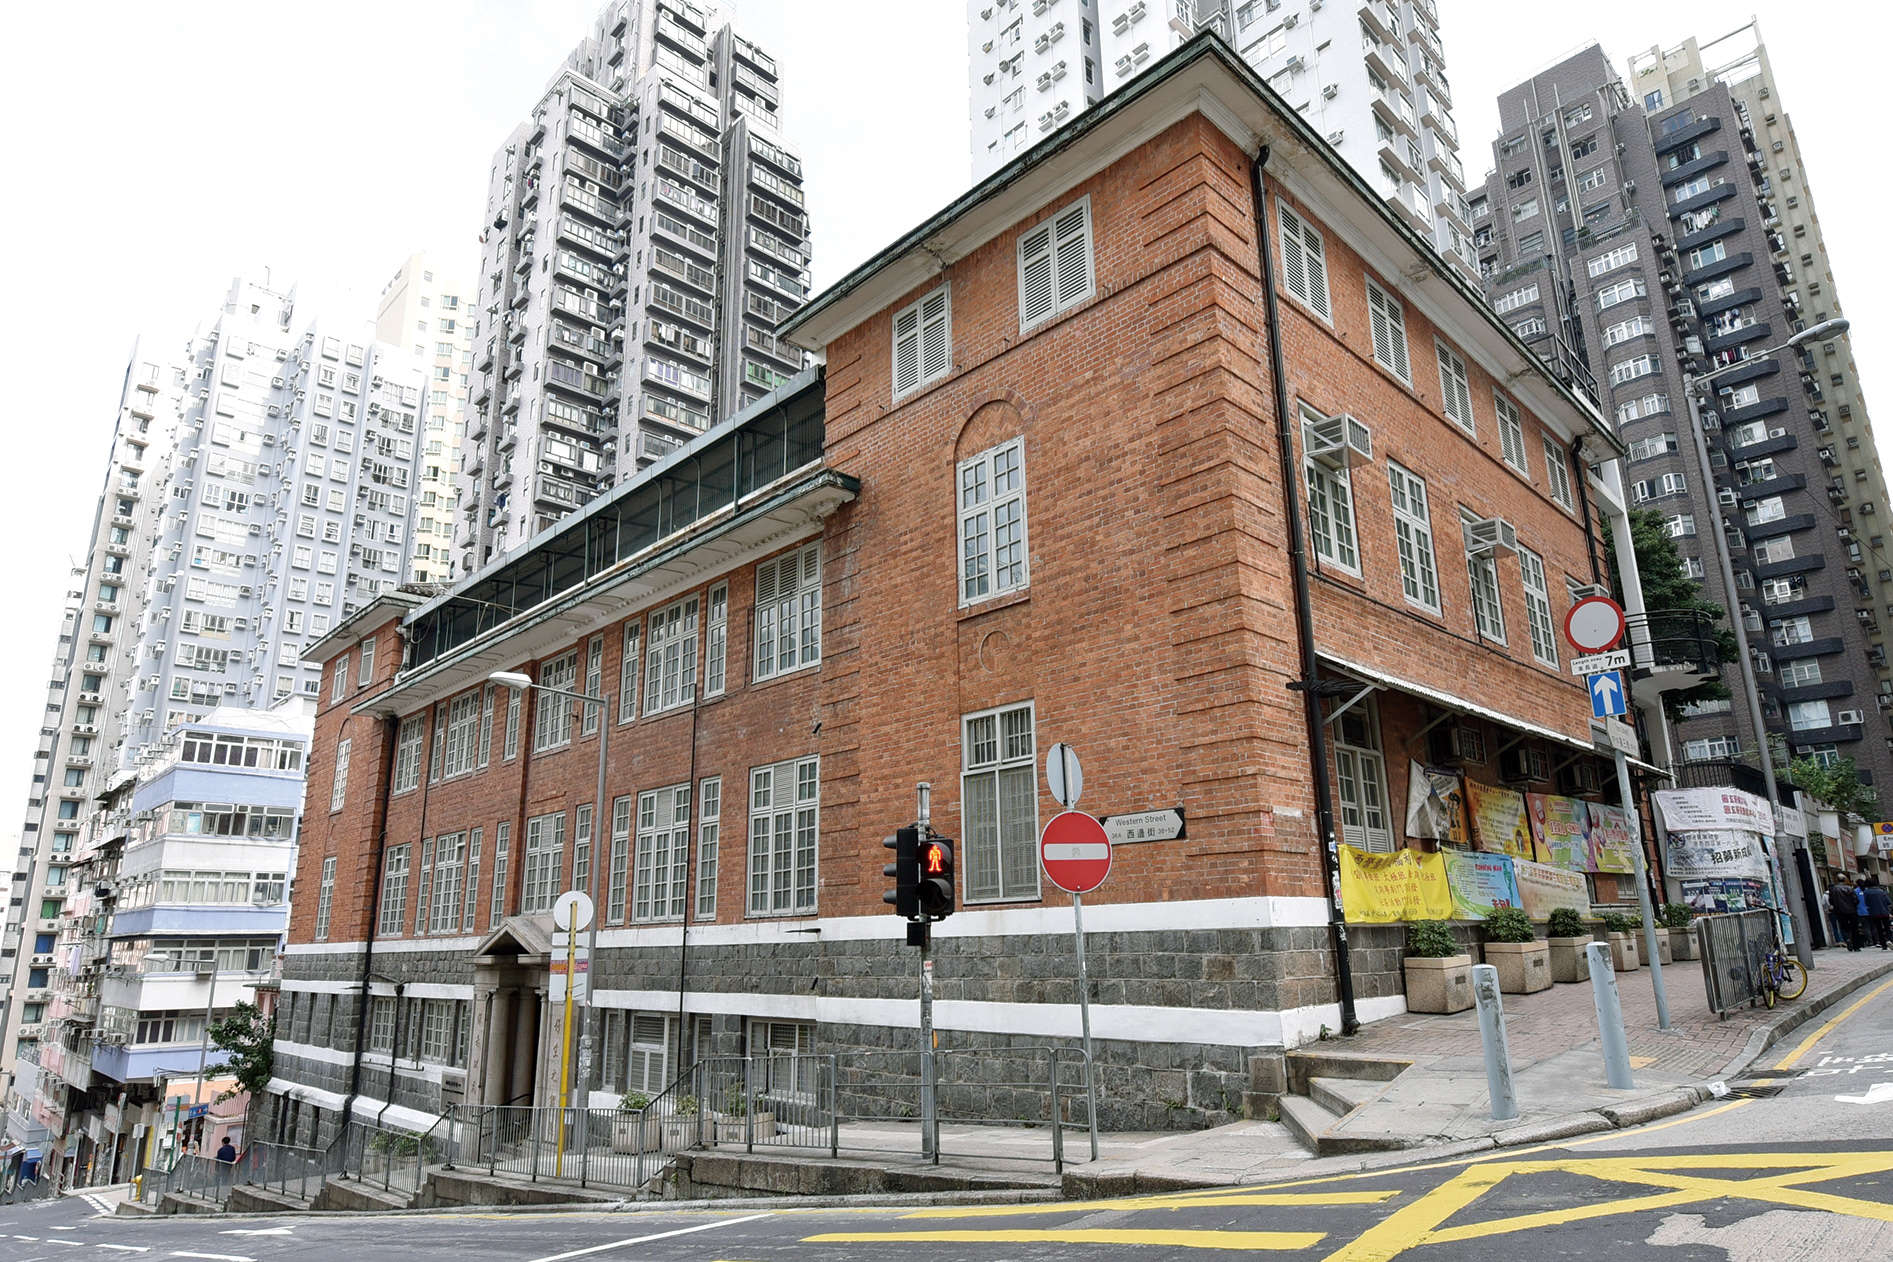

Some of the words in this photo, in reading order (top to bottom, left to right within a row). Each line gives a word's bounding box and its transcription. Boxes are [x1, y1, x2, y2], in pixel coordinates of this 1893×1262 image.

[1605, 655, 1625, 666] 7m
[1115, 817, 1144, 827] Western
[1144, 814, 1167, 824] Street
[1127, 828, 1155, 838] 西邊街
